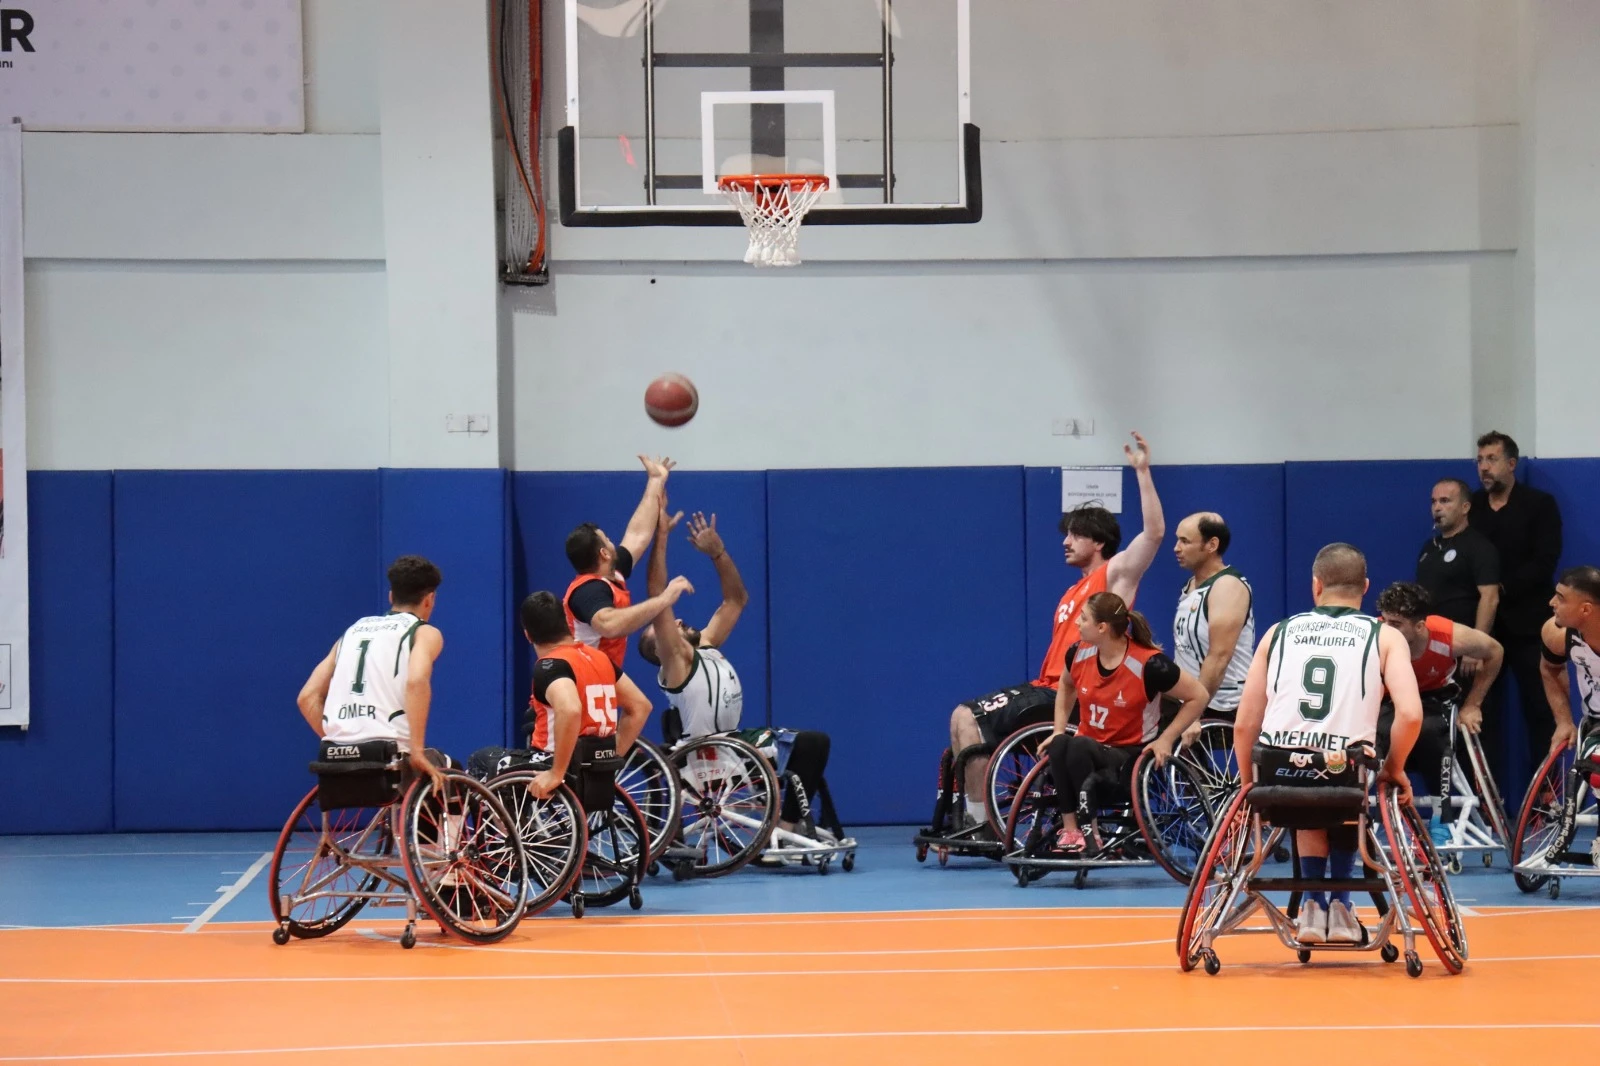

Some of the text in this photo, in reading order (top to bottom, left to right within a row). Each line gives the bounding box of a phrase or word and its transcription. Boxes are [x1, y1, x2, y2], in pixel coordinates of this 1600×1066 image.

[1293, 634, 1356, 648] ŞANLIURFA
[350, 638, 374, 696] 1
[1297, 655, 1338, 723] 9
[338, 703, 377, 720] ÖMER
[585, 684, 618, 737] 55
[1089, 703, 1109, 730] 17
[326, 746, 360, 756] EXTRA
[1273, 730, 1350, 752] MEHMET
[791, 774, 811, 817] EXTRA
[1441, 756, 1451, 801] EXTRA
